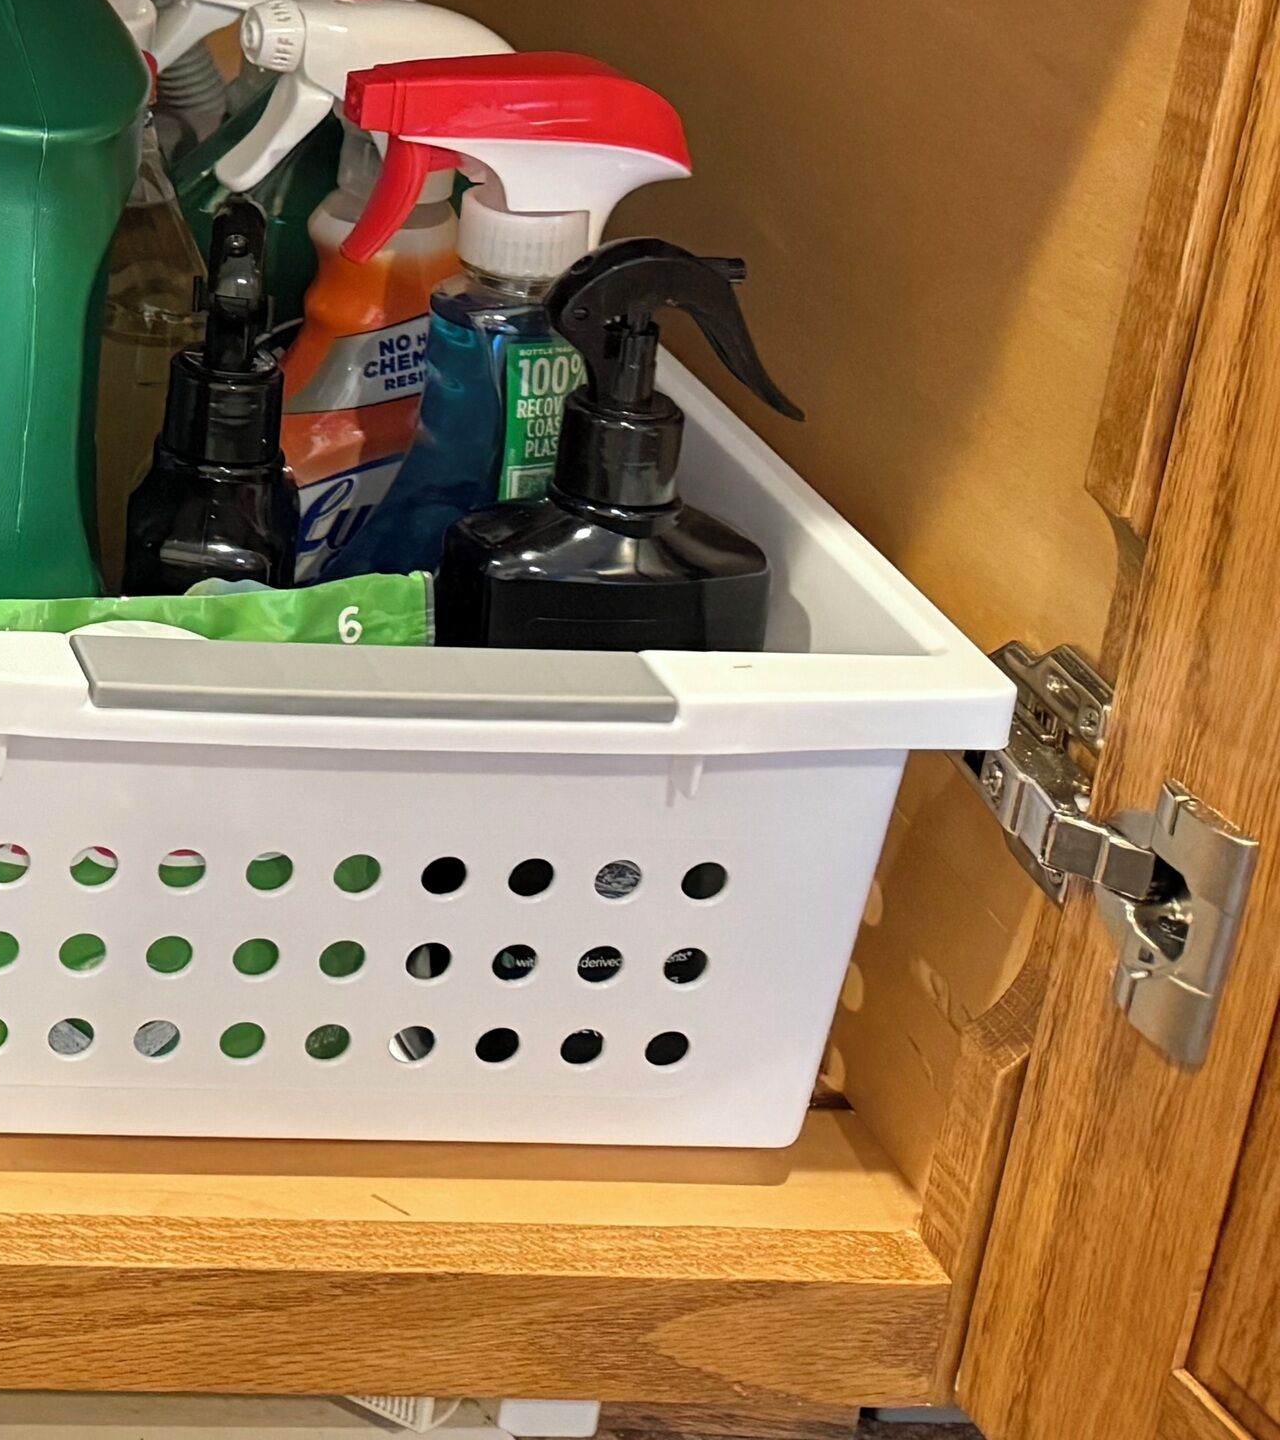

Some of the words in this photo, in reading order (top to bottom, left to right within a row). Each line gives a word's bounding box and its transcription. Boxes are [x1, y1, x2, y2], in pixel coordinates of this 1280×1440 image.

[379, 334, 412, 357] NO
[363, 349, 428, 378] CHEM
[384, 370, 424, 391] RESI
[519, 353, 589, 397] 100%
[516, 397, 564, 419] RECOV
[526, 416, 561, 438] COAS
[524, 437, 559, 459] PLAS
[338, 606, 363, 645] 6
